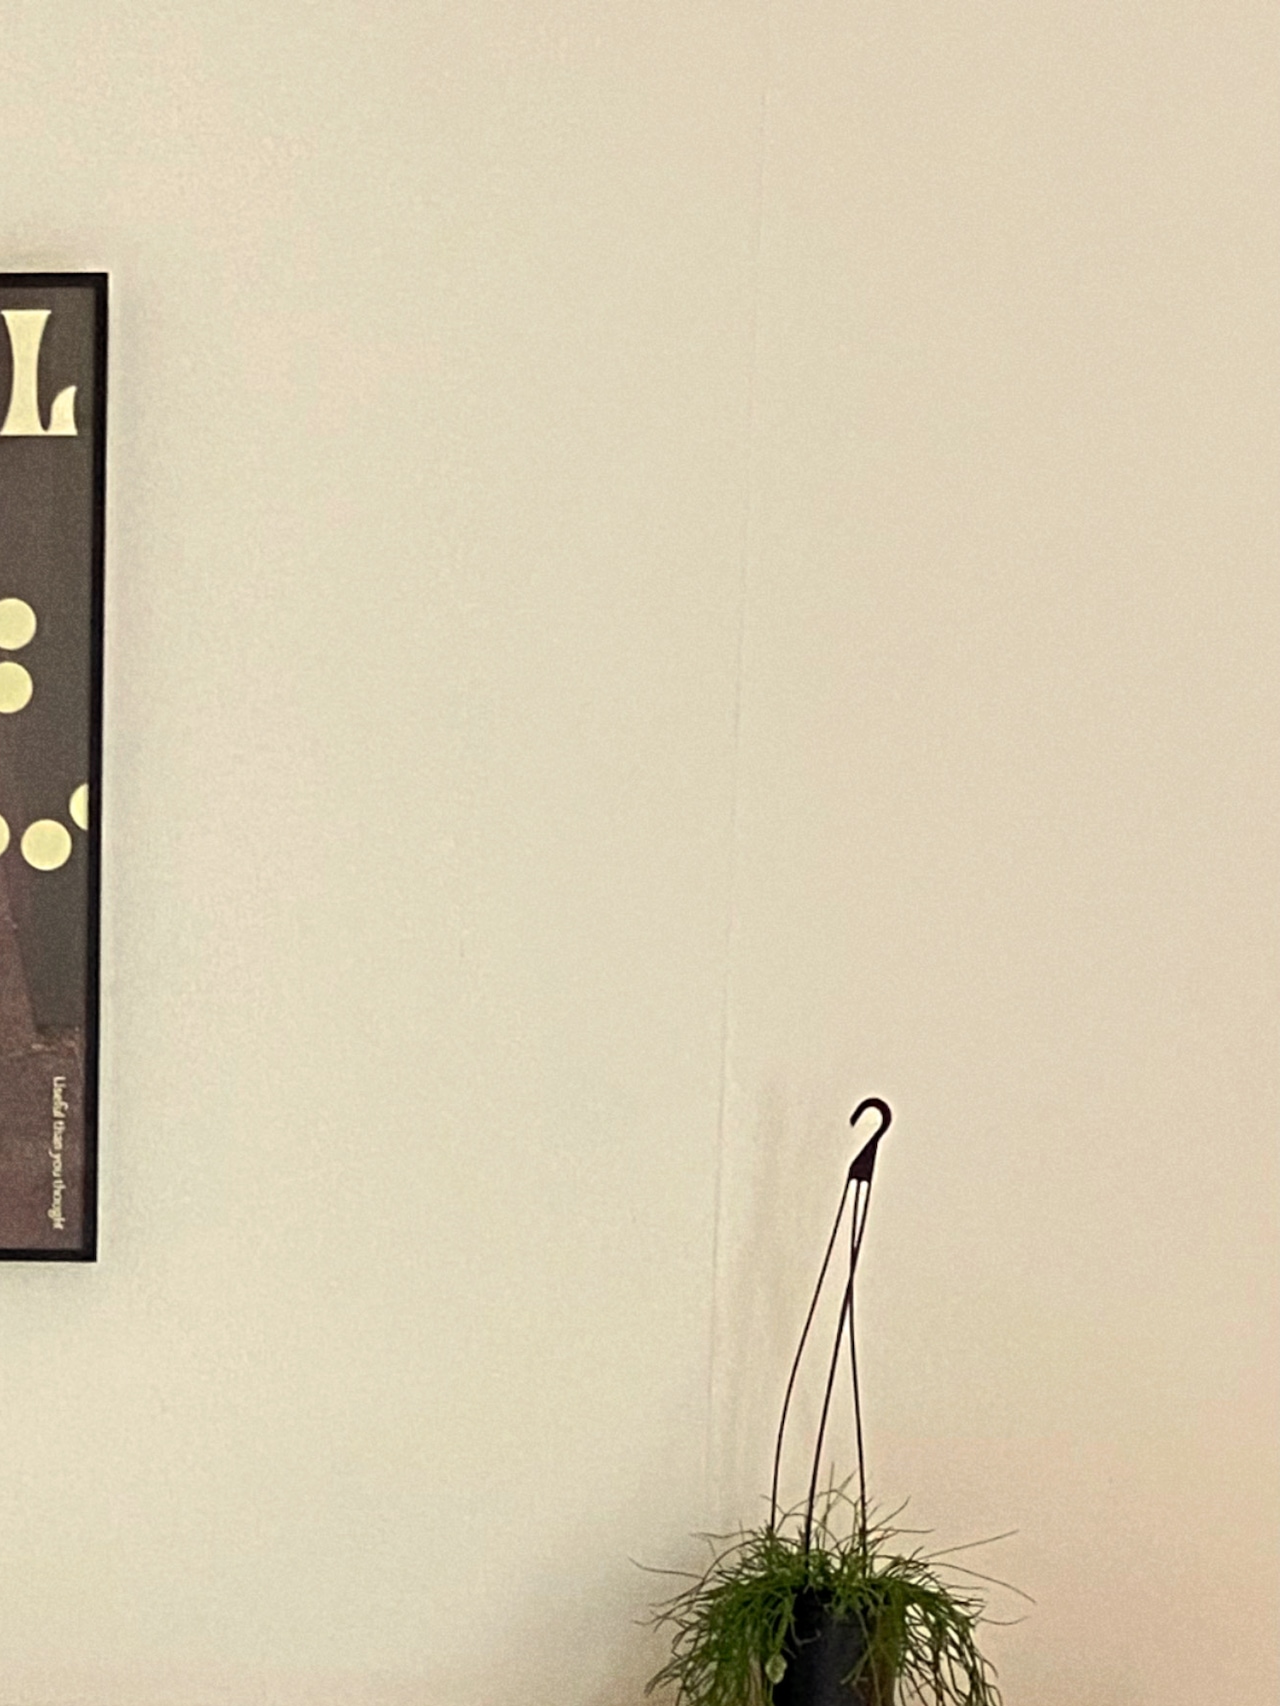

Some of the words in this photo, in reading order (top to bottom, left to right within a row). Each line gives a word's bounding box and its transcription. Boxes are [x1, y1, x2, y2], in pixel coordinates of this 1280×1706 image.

[52, 1075, 69, 1118] Useful
[52, 1120, 66, 1150] than
[48, 1149, 63, 1178] you
[47, 1179, 66, 1230] thought
